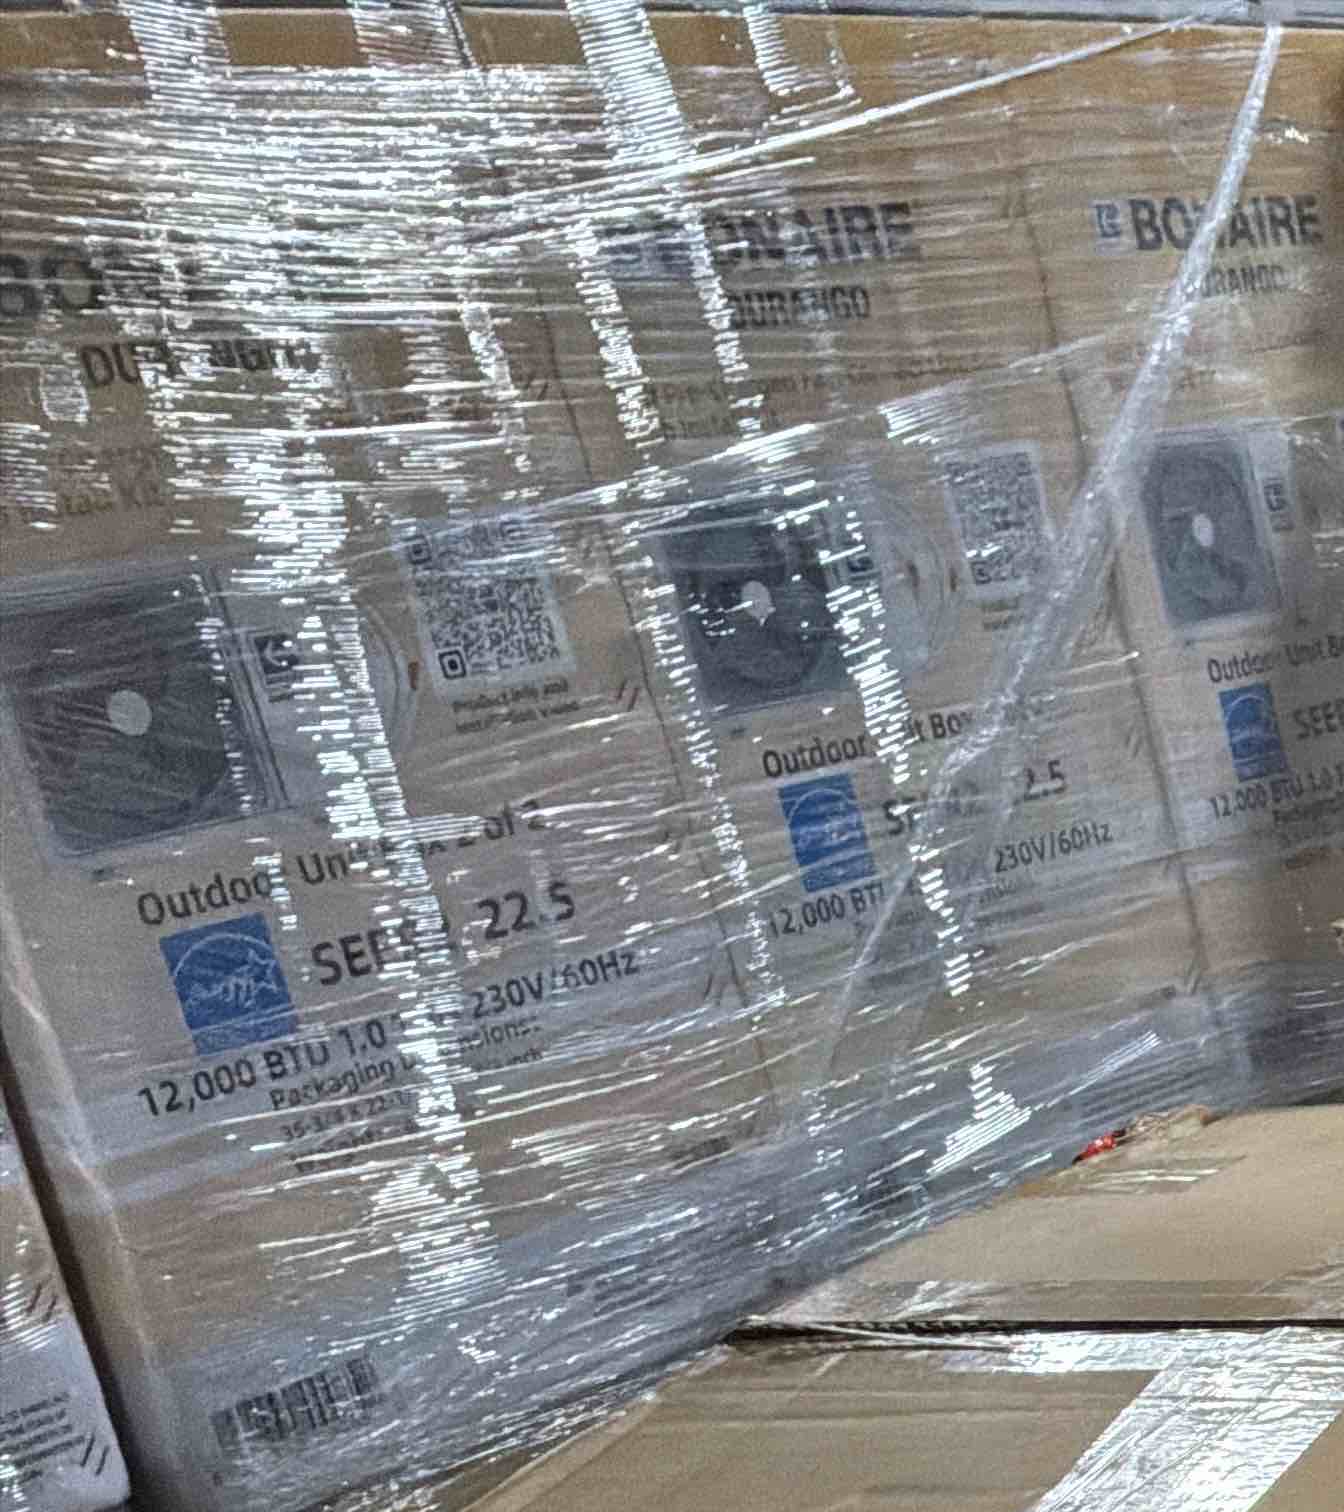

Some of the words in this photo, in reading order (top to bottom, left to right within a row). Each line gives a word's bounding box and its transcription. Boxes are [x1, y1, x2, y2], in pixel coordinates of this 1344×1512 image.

[1128, 195, 1323, 251] BOAIRE
[761, 730, 874, 779] Outdoor
[476, 879, 577, 940] 22.5
[136, 1060, 258, 1118] 12,000
[264, 1033, 329, 1083] BTU
